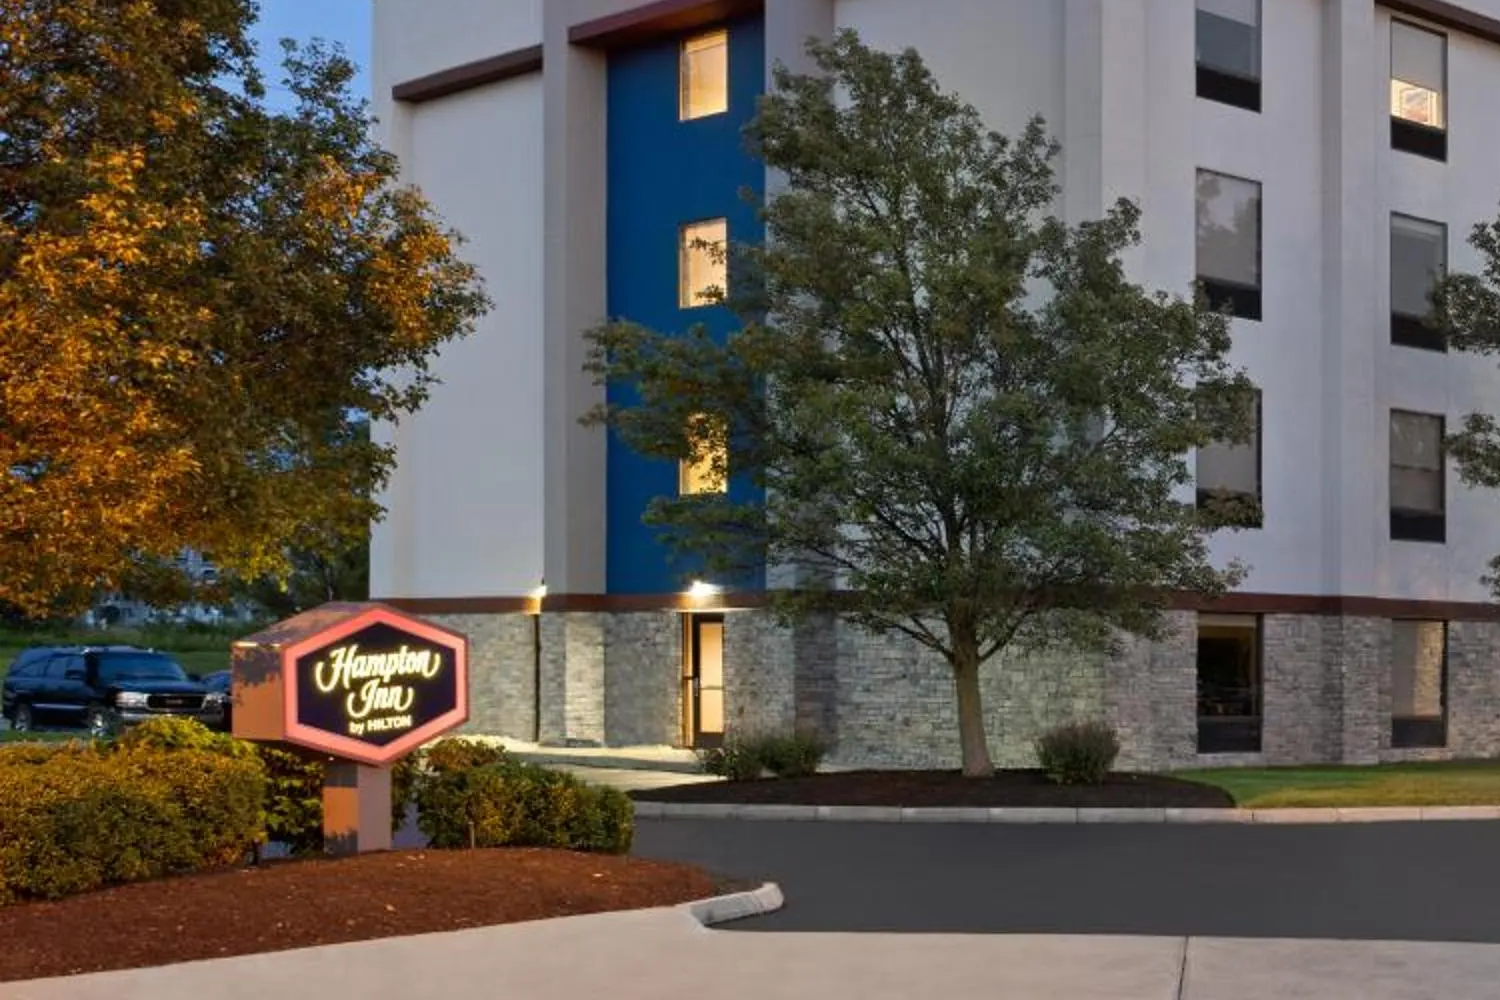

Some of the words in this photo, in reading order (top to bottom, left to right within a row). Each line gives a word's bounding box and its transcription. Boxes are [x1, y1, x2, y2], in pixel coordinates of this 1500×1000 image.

[314, 644, 442, 693] Hampton
[346, 676, 415, 719] Inn
[348, 719, 365, 737] by
[367, 714, 412, 732] HILTON
